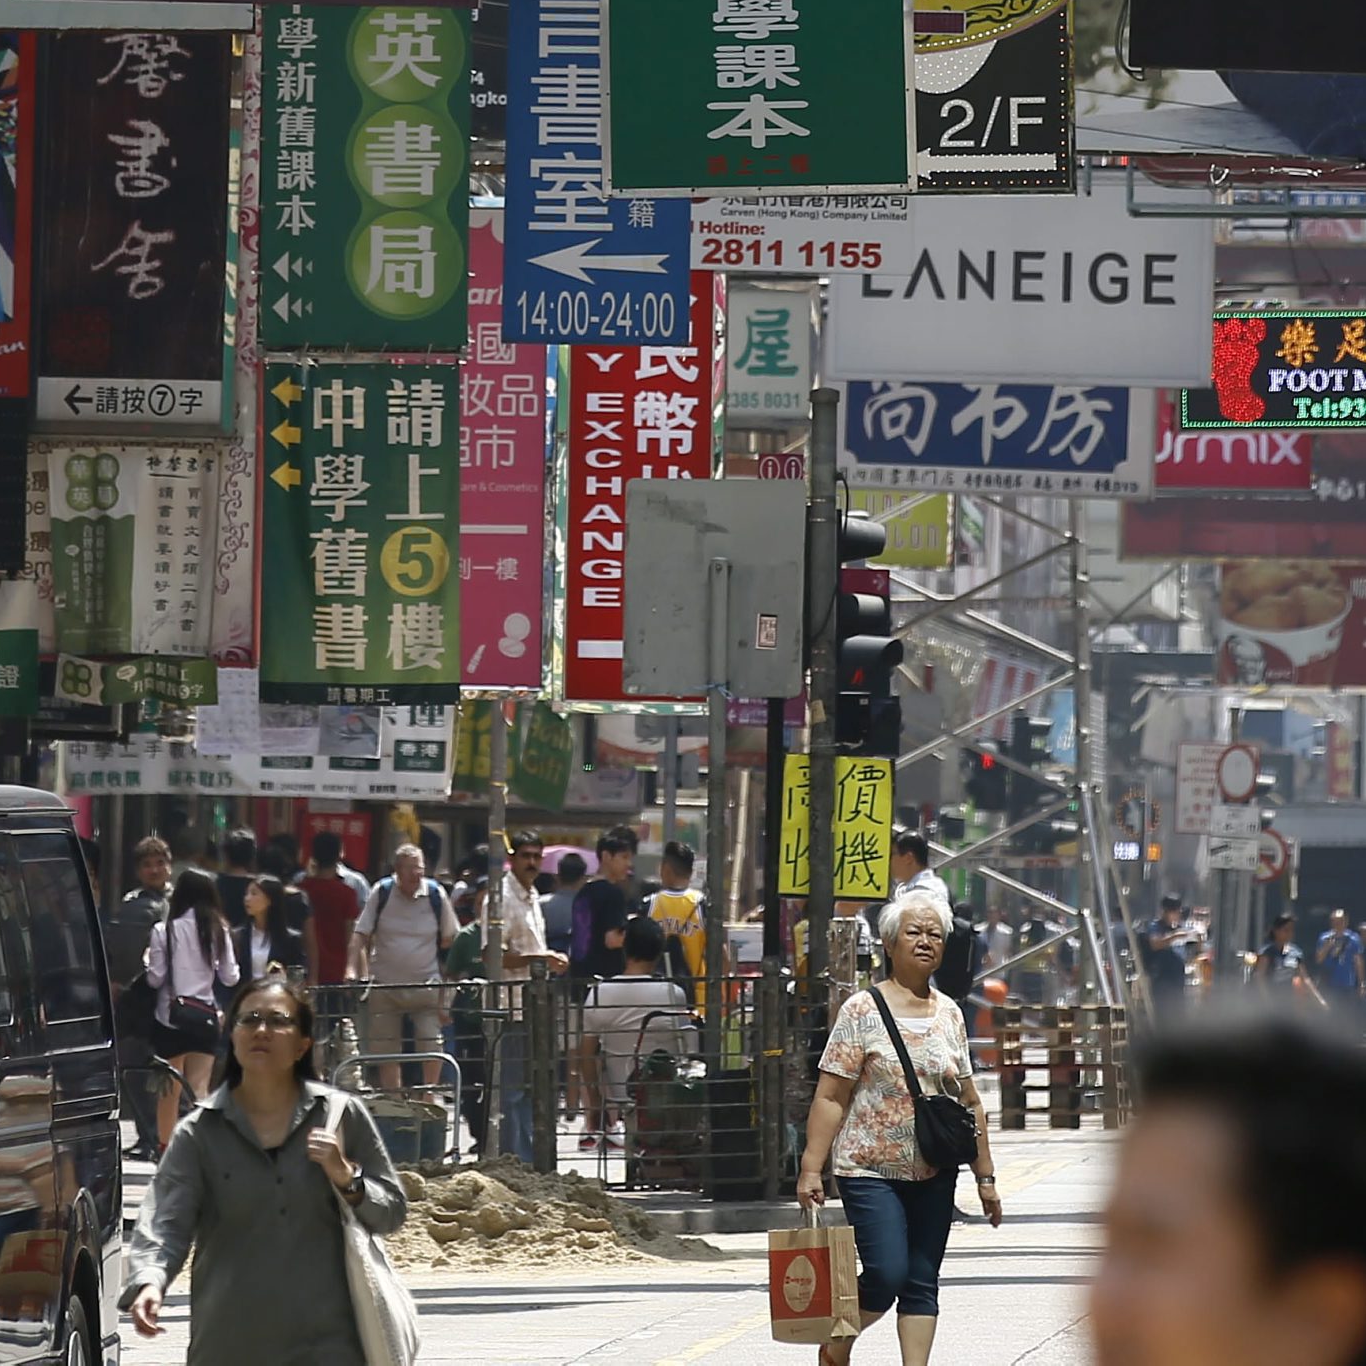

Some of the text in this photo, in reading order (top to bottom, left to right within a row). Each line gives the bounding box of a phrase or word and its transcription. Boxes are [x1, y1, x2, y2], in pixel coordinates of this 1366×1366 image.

[275, 5, 318, 236] 學新舊課本
[938, 95, 1047, 147] 2/F
[698, 220, 766, 236] Hotline:
[720, 207, 908, 222] Carven (Hong Kong) Company Limited
[700, 238, 883, 270] 2811 1155
[517, 290, 675, 339] 14:00-24:00
[1267, 368, 1348, 393] FOOT
